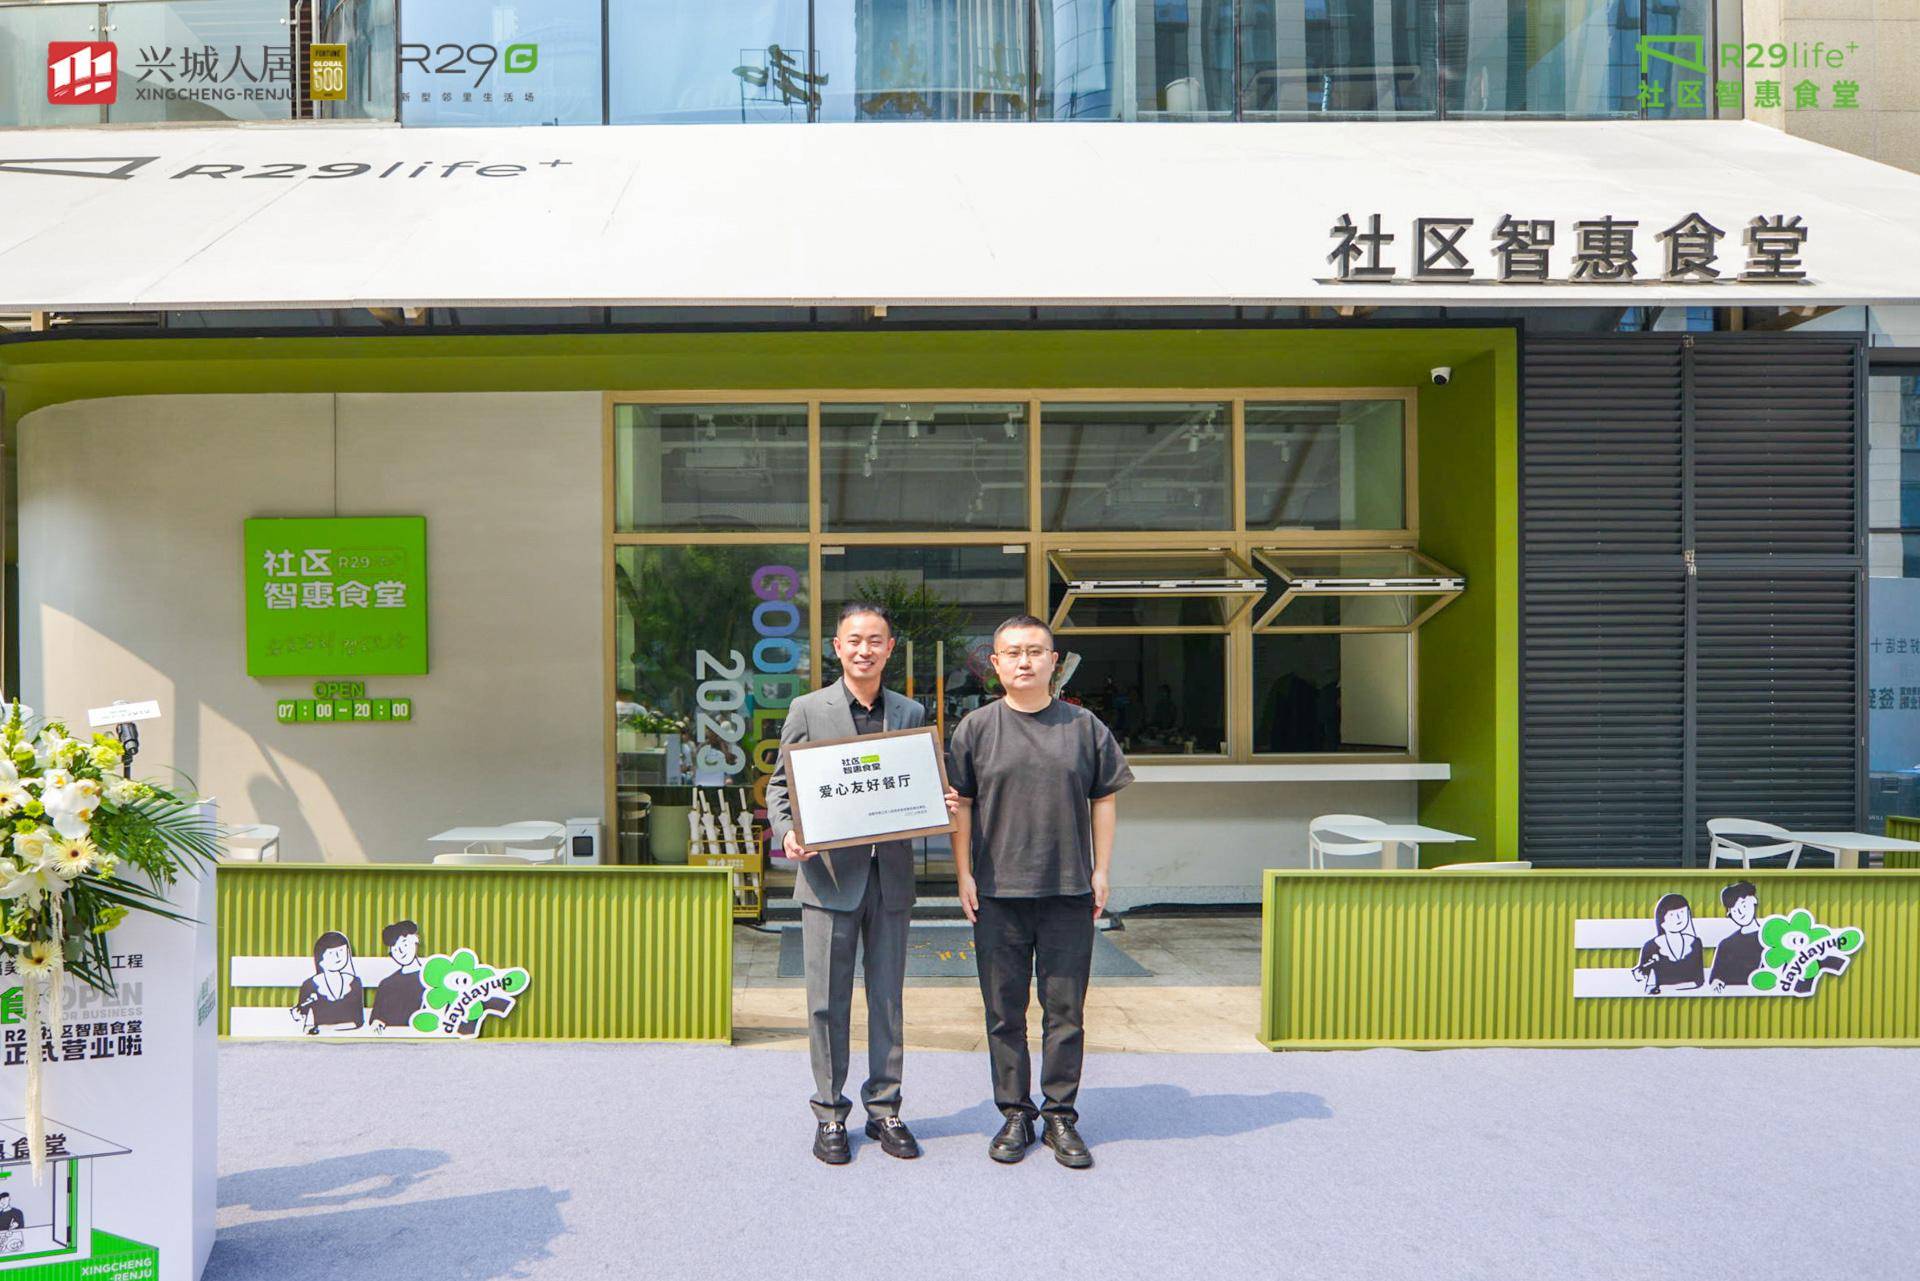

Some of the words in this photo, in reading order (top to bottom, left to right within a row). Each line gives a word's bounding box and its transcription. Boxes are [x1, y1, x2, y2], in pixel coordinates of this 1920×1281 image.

[1326, 211, 1809, 283] 社区智惠食堂
[263, 549, 332, 576] 社区
[264, 581, 407, 609] 智惠食堂
[314, 682, 365, 697] OPEN
[696, 649, 746, 776] 2023
[819, 774, 911, 799] 爱心友好餐厅
[1780, 935, 1848, 993] daydayup
[83, 1007, 143, 1018] BUSINESS
[444, 976, 512, 1033] daydayup
[81, 1257, 153, 1276] XINGCHENG
